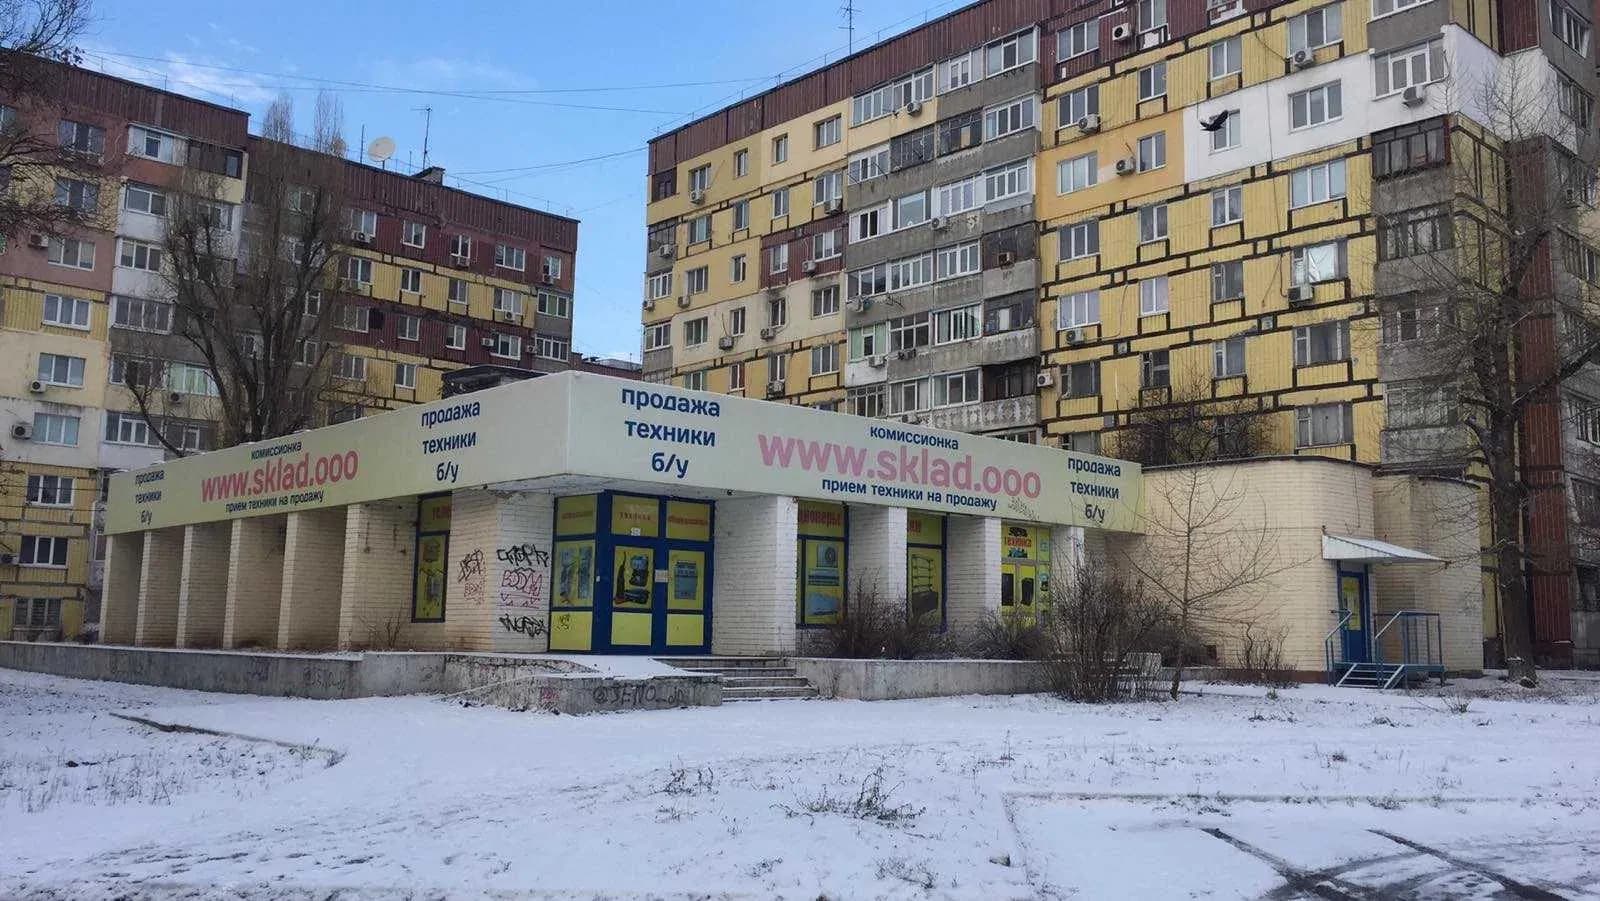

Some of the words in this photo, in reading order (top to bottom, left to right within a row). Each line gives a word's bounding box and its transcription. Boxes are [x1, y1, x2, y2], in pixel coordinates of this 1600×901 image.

[622, 388, 720, 417] продажа
[421, 401, 480, 429] продажа
[422, 432, 477, 455] техники
[624, 420, 716, 447] техники
[870, 426, 959, 450] комиссионка
[251, 441, 302, 460] комиссионка
[201, 450, 359, 502] www.sklad.ooo
[436, 461, 459, 483] б/у
[651, 452, 689, 479] б/у
[758, 434, 1041, 499] www.sklad.ooo
[1068, 458, 1121, 477] продажа
[135, 470, 165, 487] продажа
[1070, 481, 1119, 499] техники
[135, 491, 162, 504] техники
[226, 502, 247, 514] прием
[248, 497, 278, 510] техники
[279, 496, 289, 506] на
[293, 490, 325, 506] продажу
[822, 479, 867, 494] прием
[871, 484, 923, 500] техники
[927, 490, 942, 503] на
[946, 493, 998, 512] продажу
[140, 510, 153, 525] б/у
[1085, 504, 1105, 523] б/у
